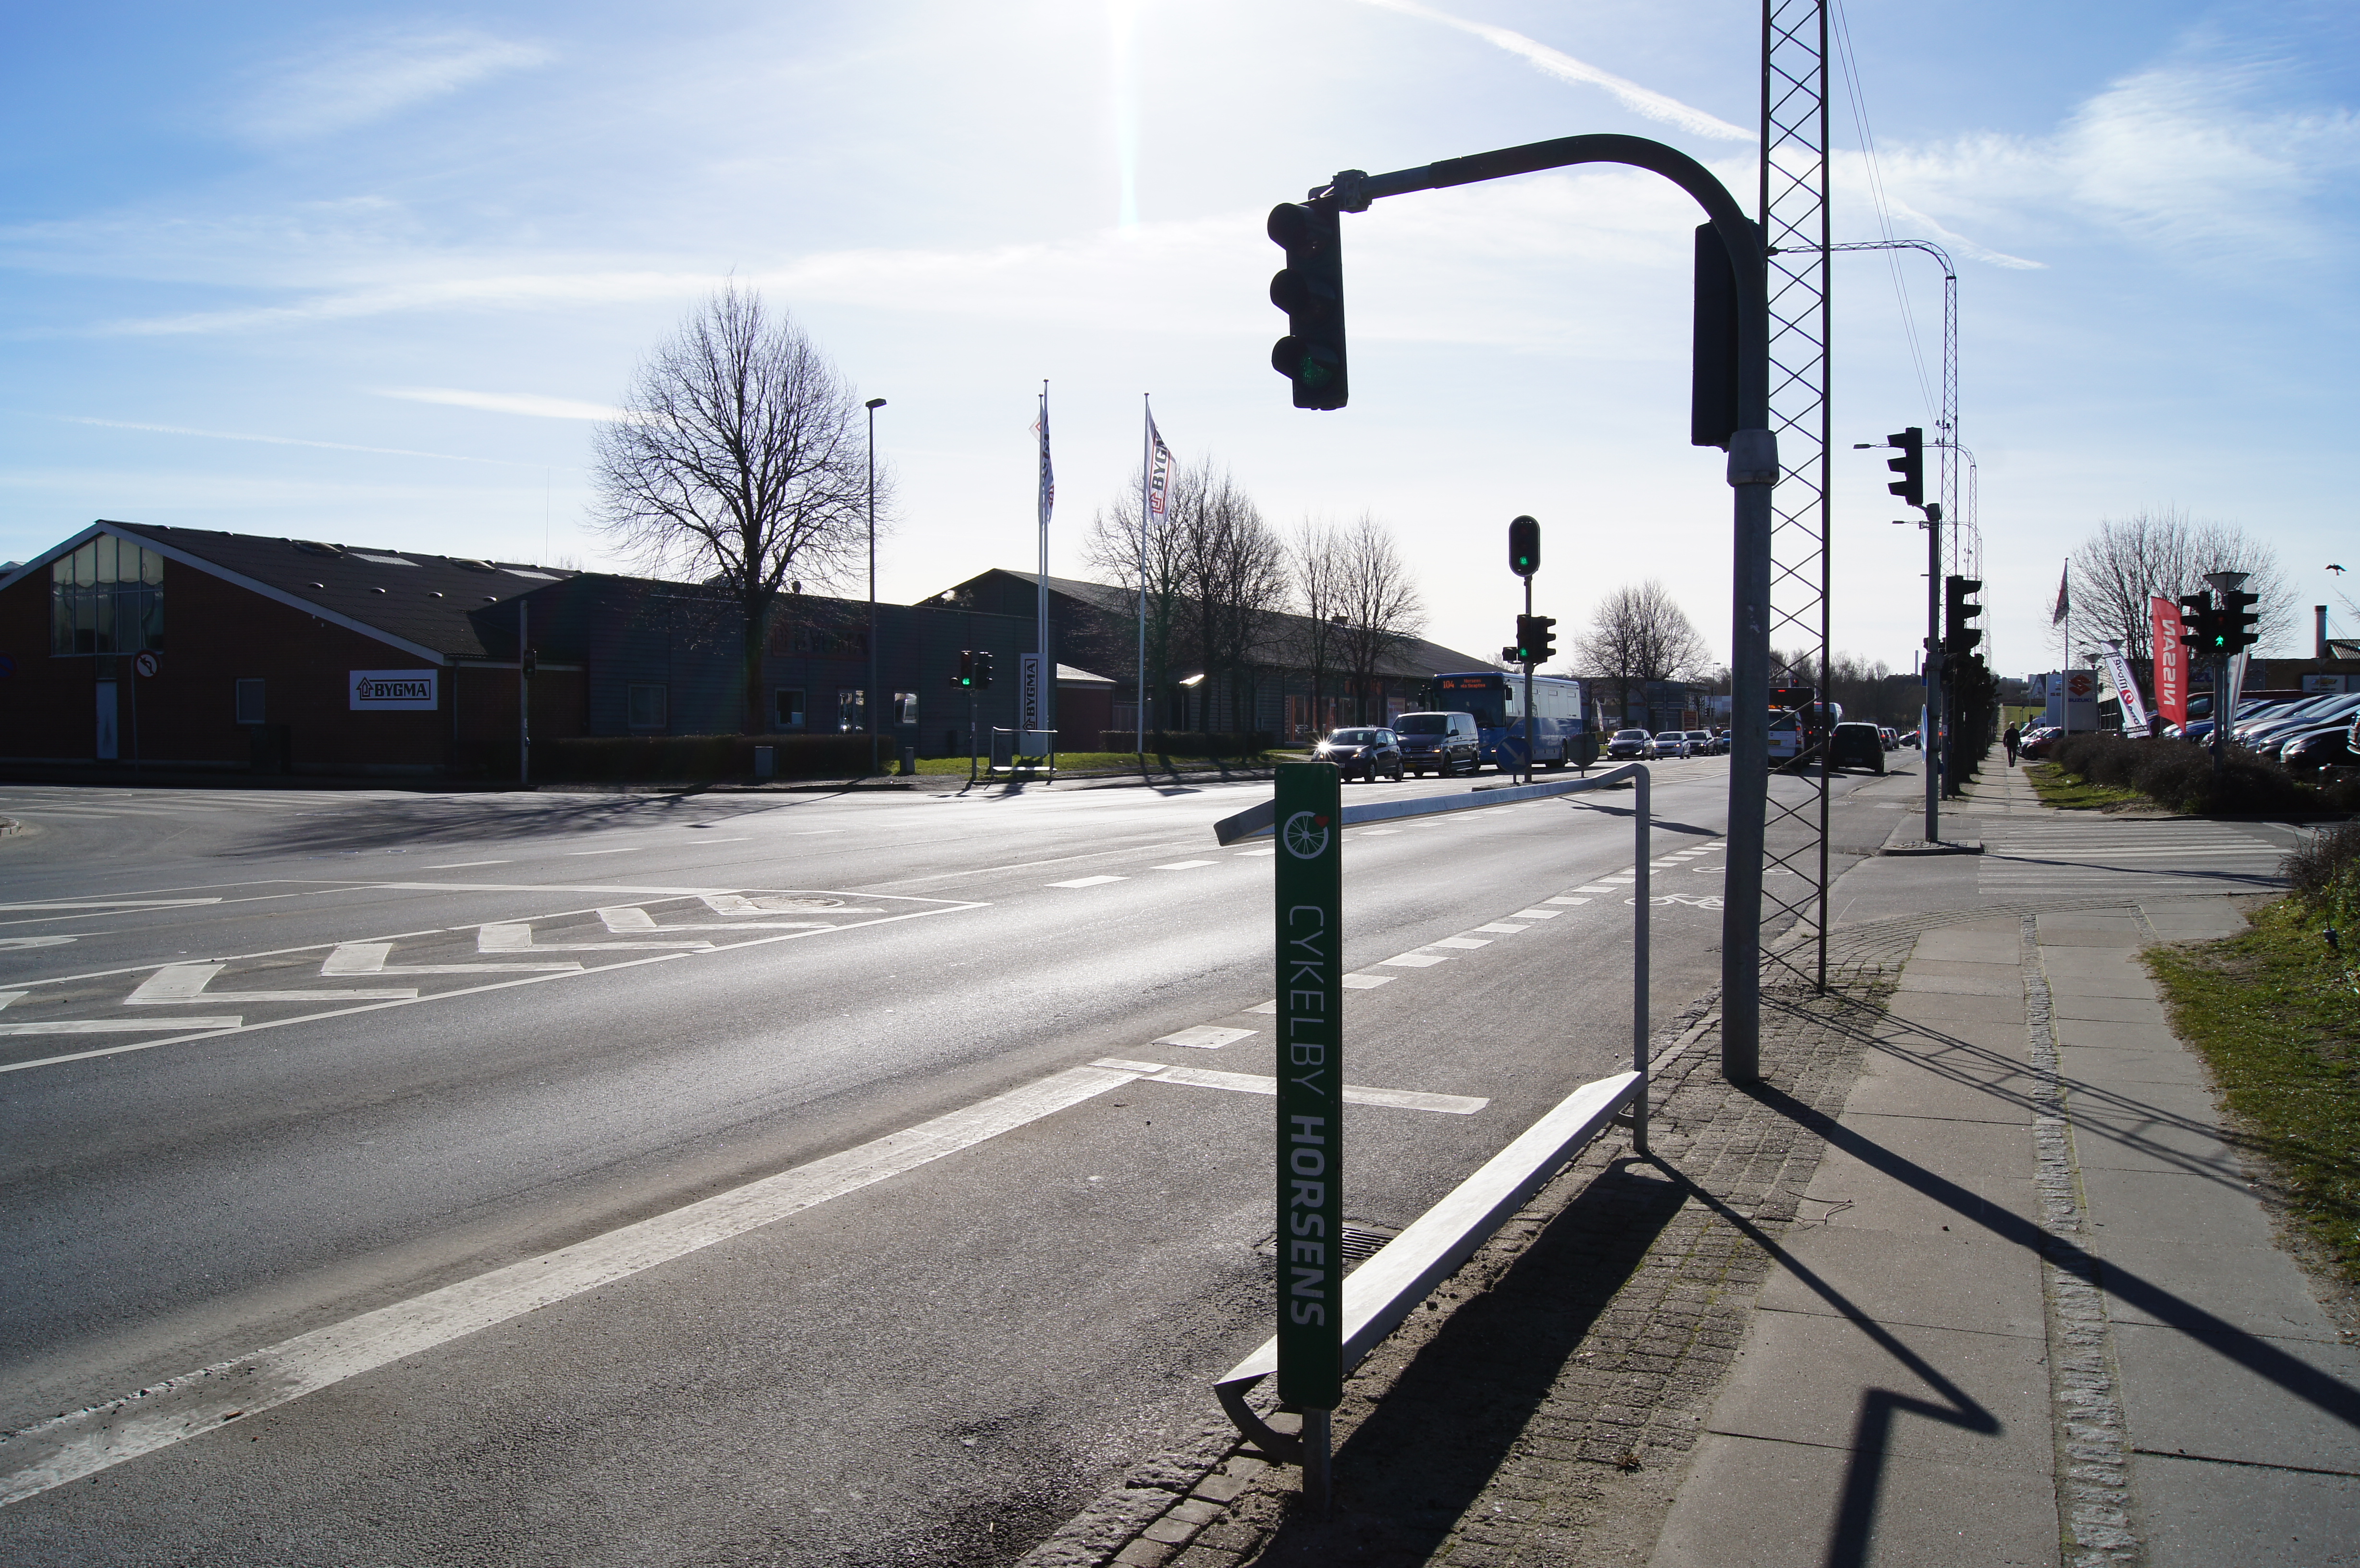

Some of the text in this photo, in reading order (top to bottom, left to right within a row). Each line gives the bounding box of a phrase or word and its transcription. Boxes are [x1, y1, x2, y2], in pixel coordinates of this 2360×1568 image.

[375, 683, 427, 697] BYGMA
[1027, 662, 1036, 716] BYGMA
[1443, 680, 1454, 689] 104
[1289, 906, 1325, 1326] CYKELBY HORSENS
